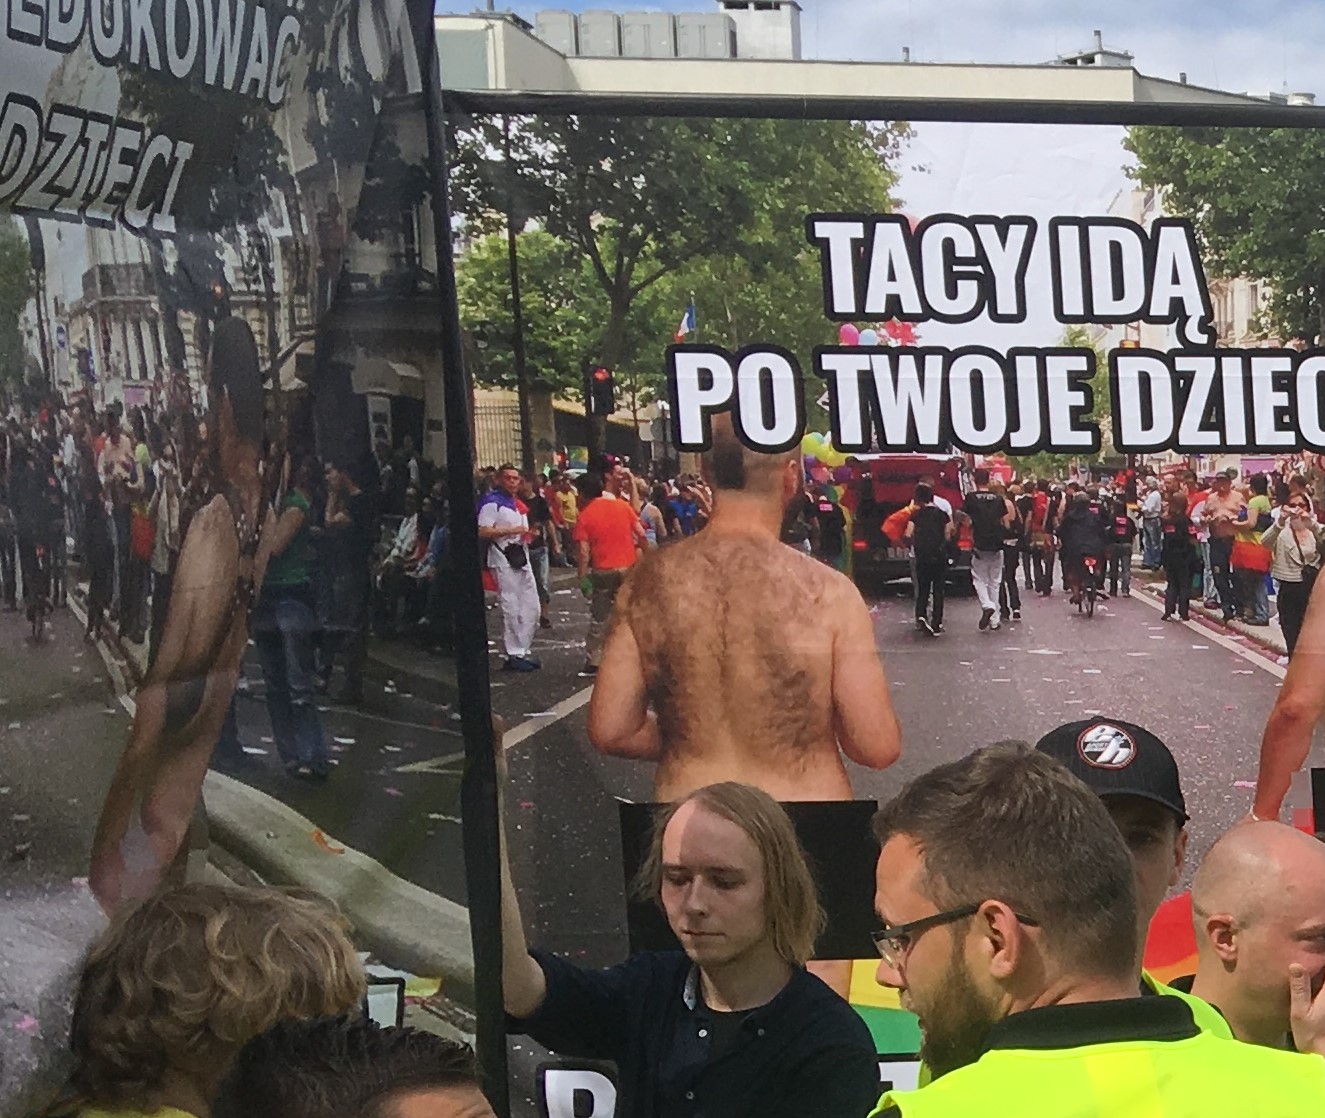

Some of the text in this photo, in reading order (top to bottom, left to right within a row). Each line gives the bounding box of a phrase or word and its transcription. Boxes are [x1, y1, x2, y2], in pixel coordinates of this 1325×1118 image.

[813, 218, 1211, 346] TACY IDĄ
[673, 351, 796, 447] PO
[821, 352, 1096, 450] TWOJE
